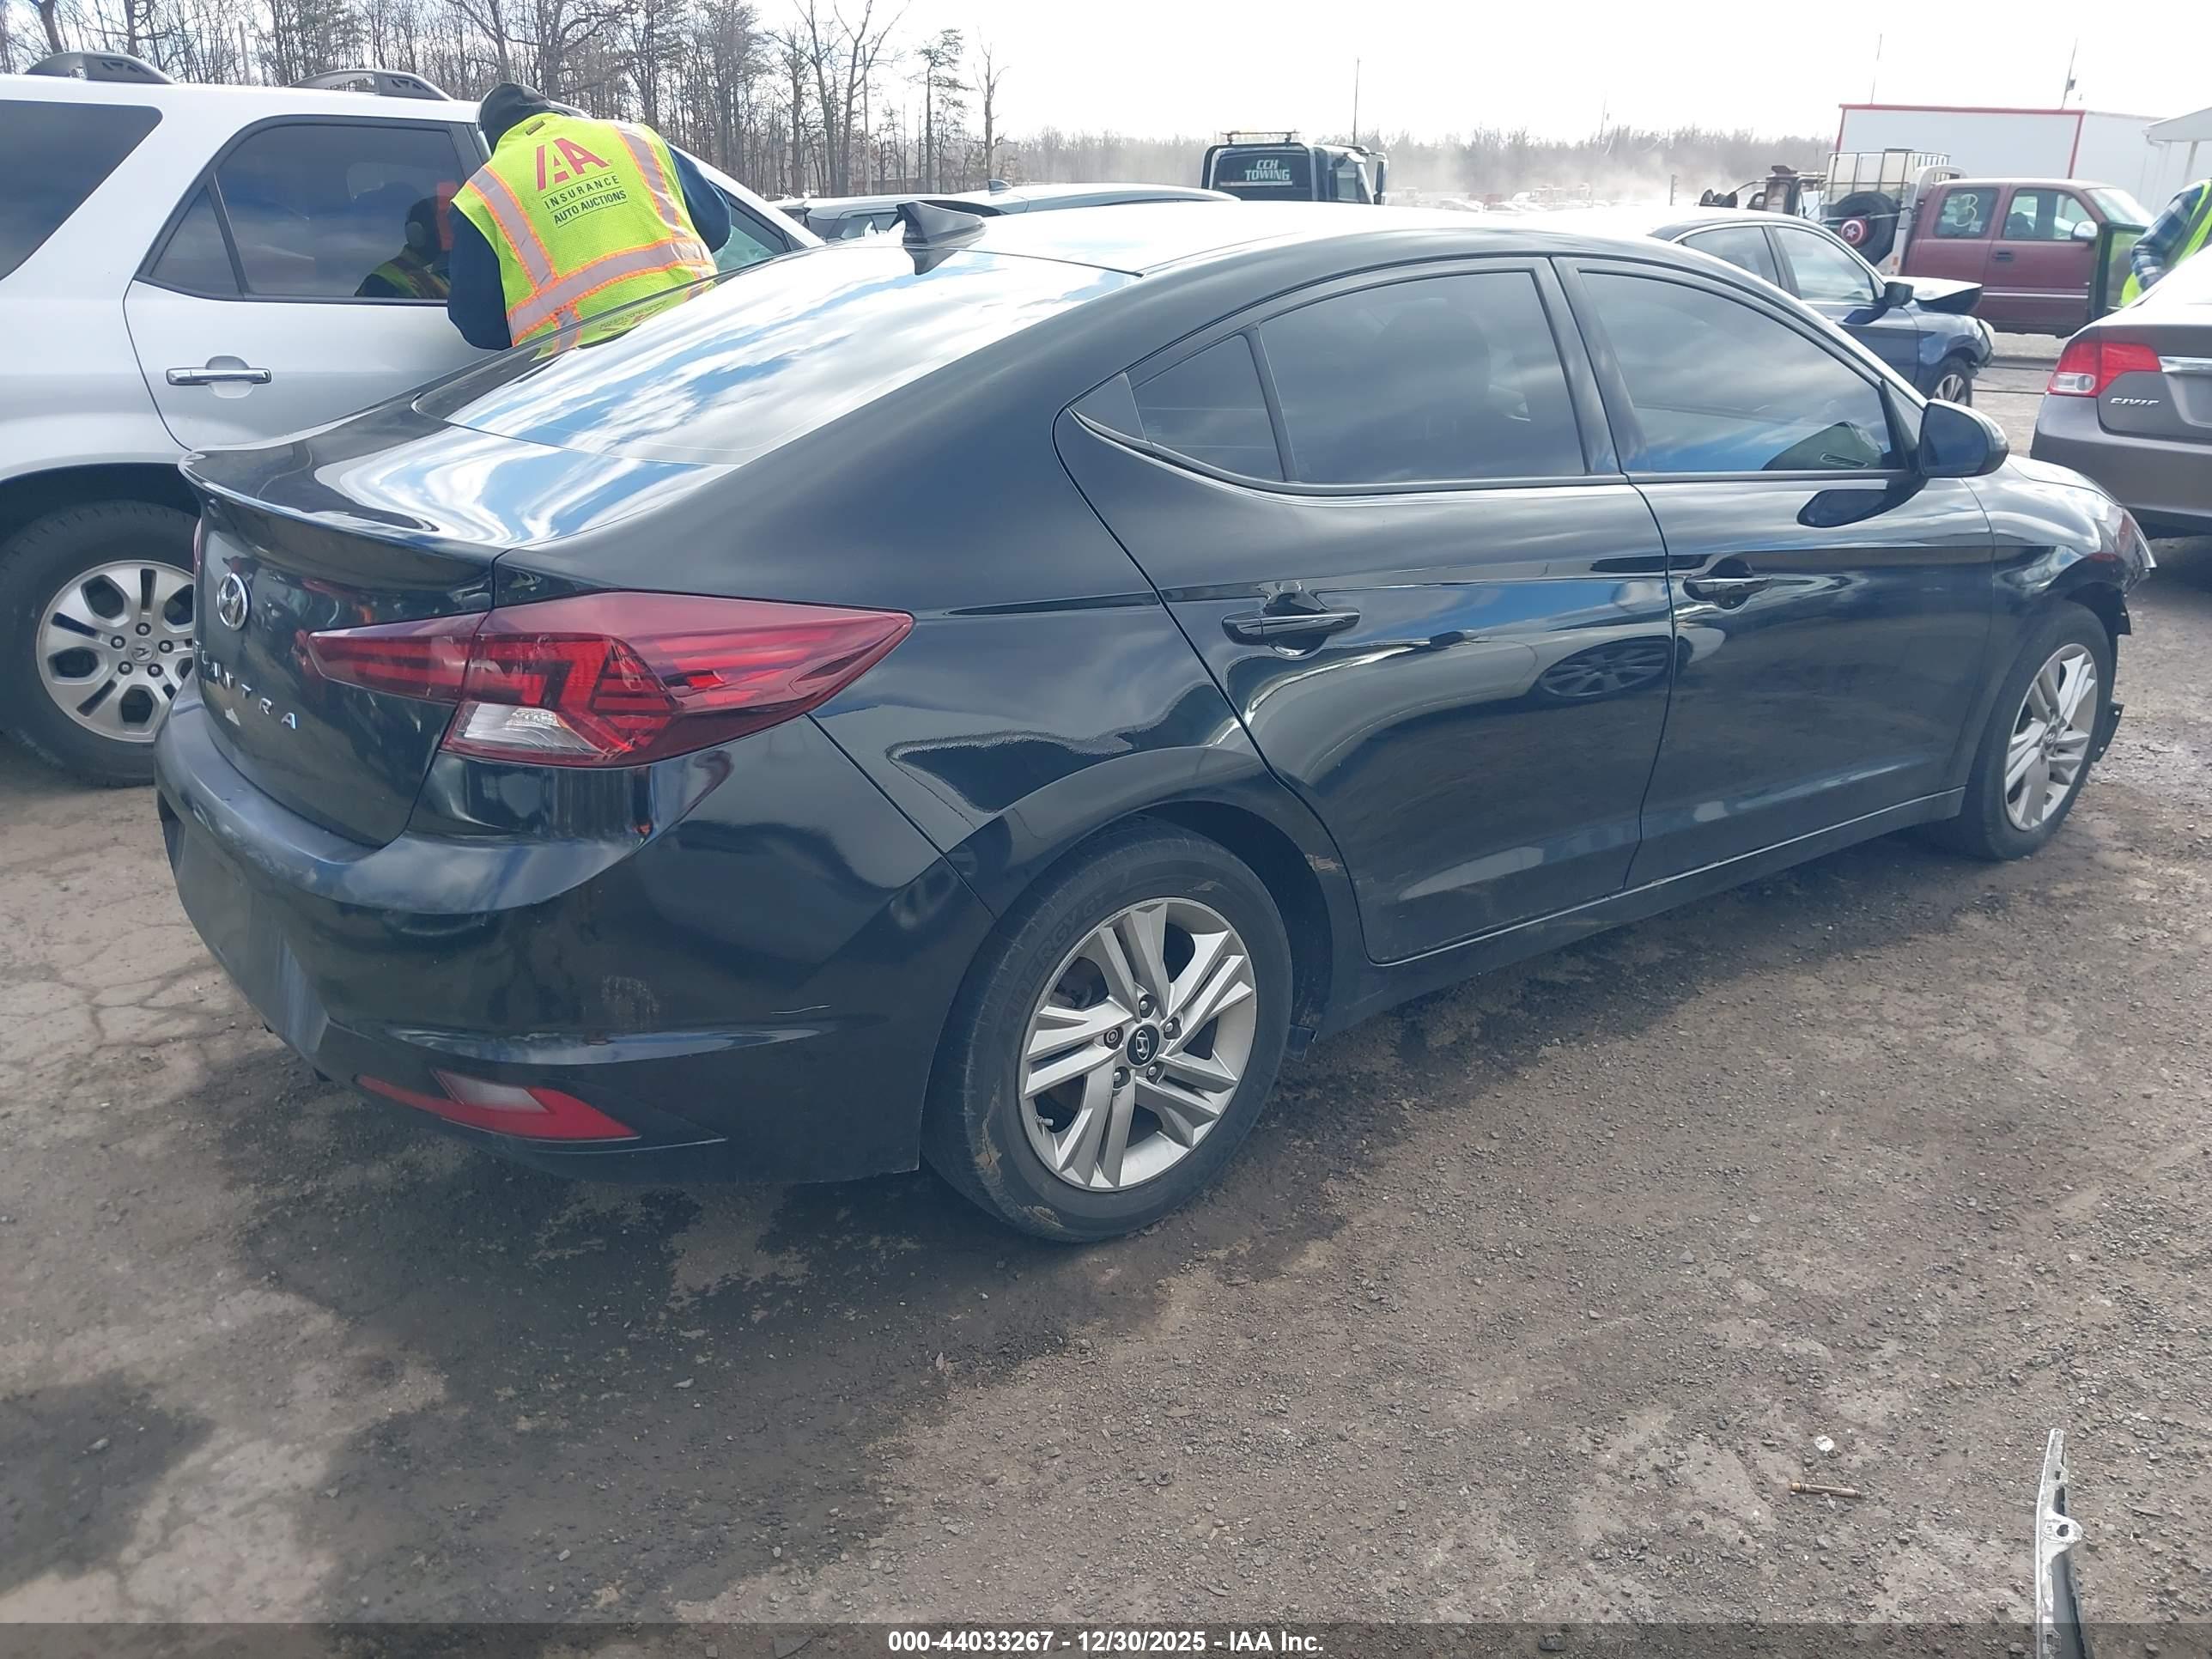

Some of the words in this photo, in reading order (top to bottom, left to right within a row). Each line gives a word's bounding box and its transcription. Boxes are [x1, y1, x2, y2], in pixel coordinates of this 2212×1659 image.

[1244, 168, 1291, 181] TOWING
[1256, 159, 1279, 170] CCH
[544, 175, 620, 210] INSURANCE
[554, 205, 580, 225] AUTO
[580, 190, 627, 212] AUCTIONS
[193, 640, 296, 730] ELANTRA
